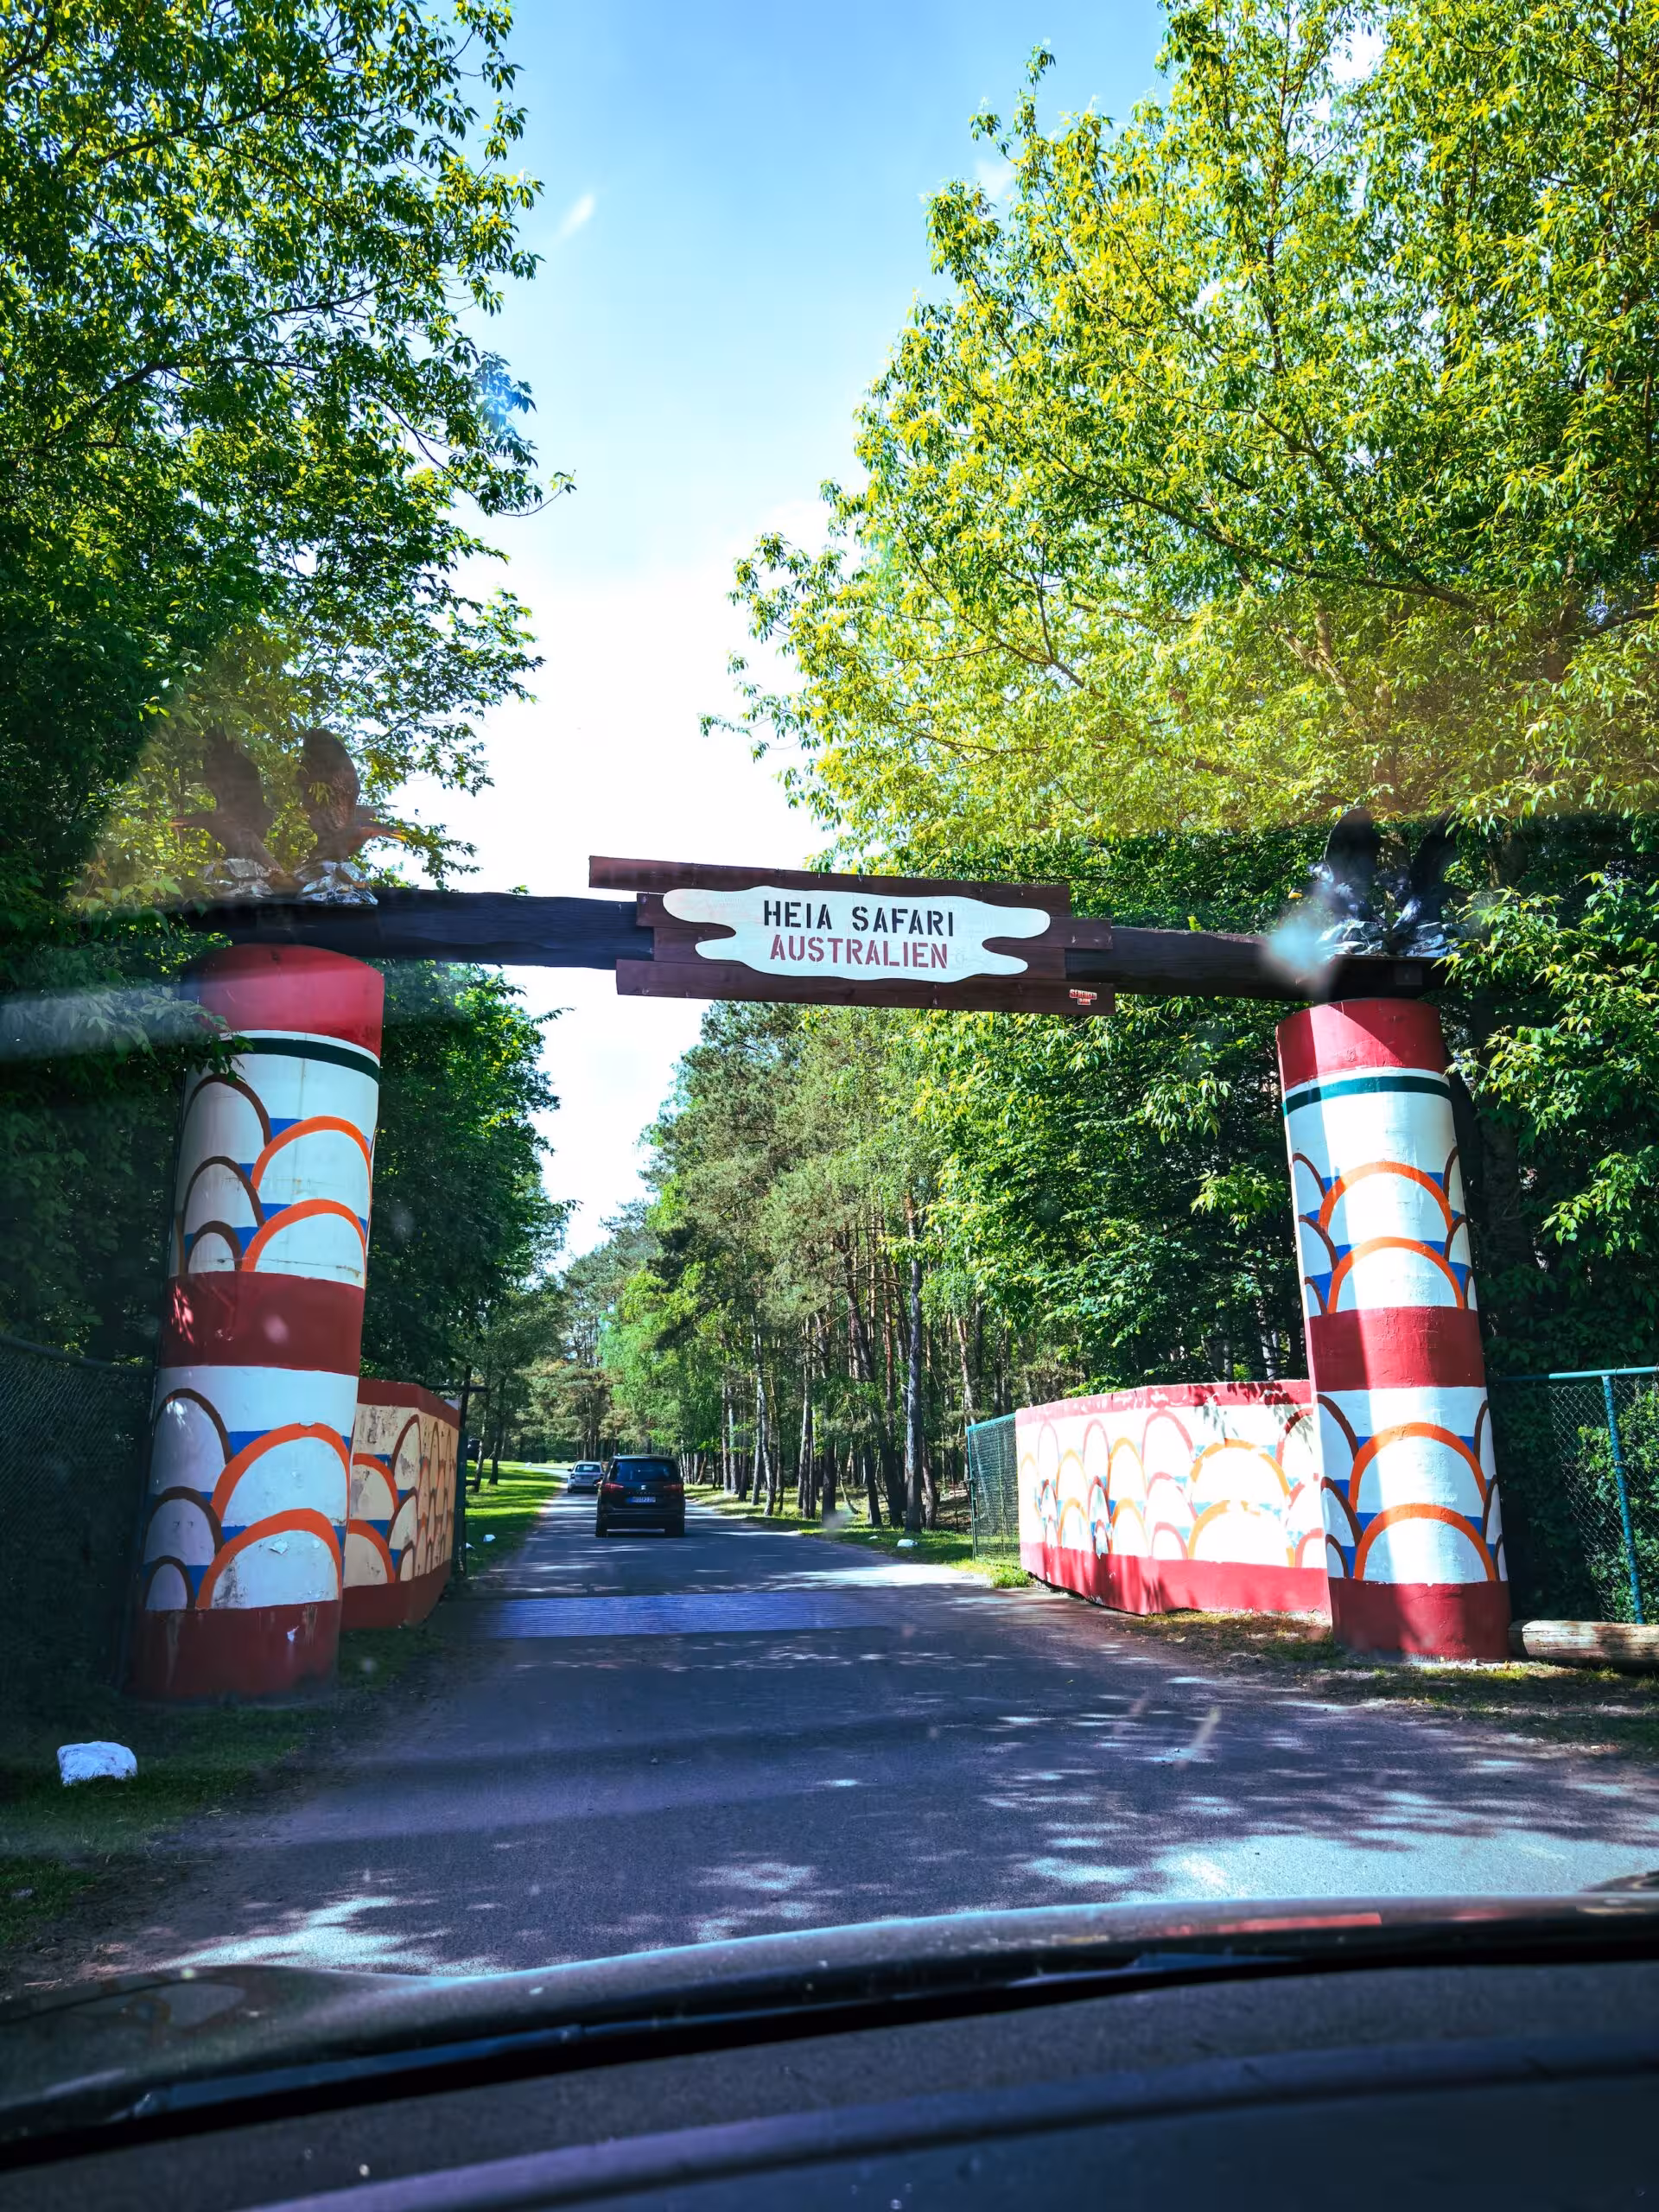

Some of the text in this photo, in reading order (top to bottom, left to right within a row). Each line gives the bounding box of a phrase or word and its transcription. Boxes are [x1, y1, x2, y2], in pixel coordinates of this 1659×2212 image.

[764, 900, 953, 937] HEIA SAFARI
[770, 934, 948, 969] AUSTRALIEN
